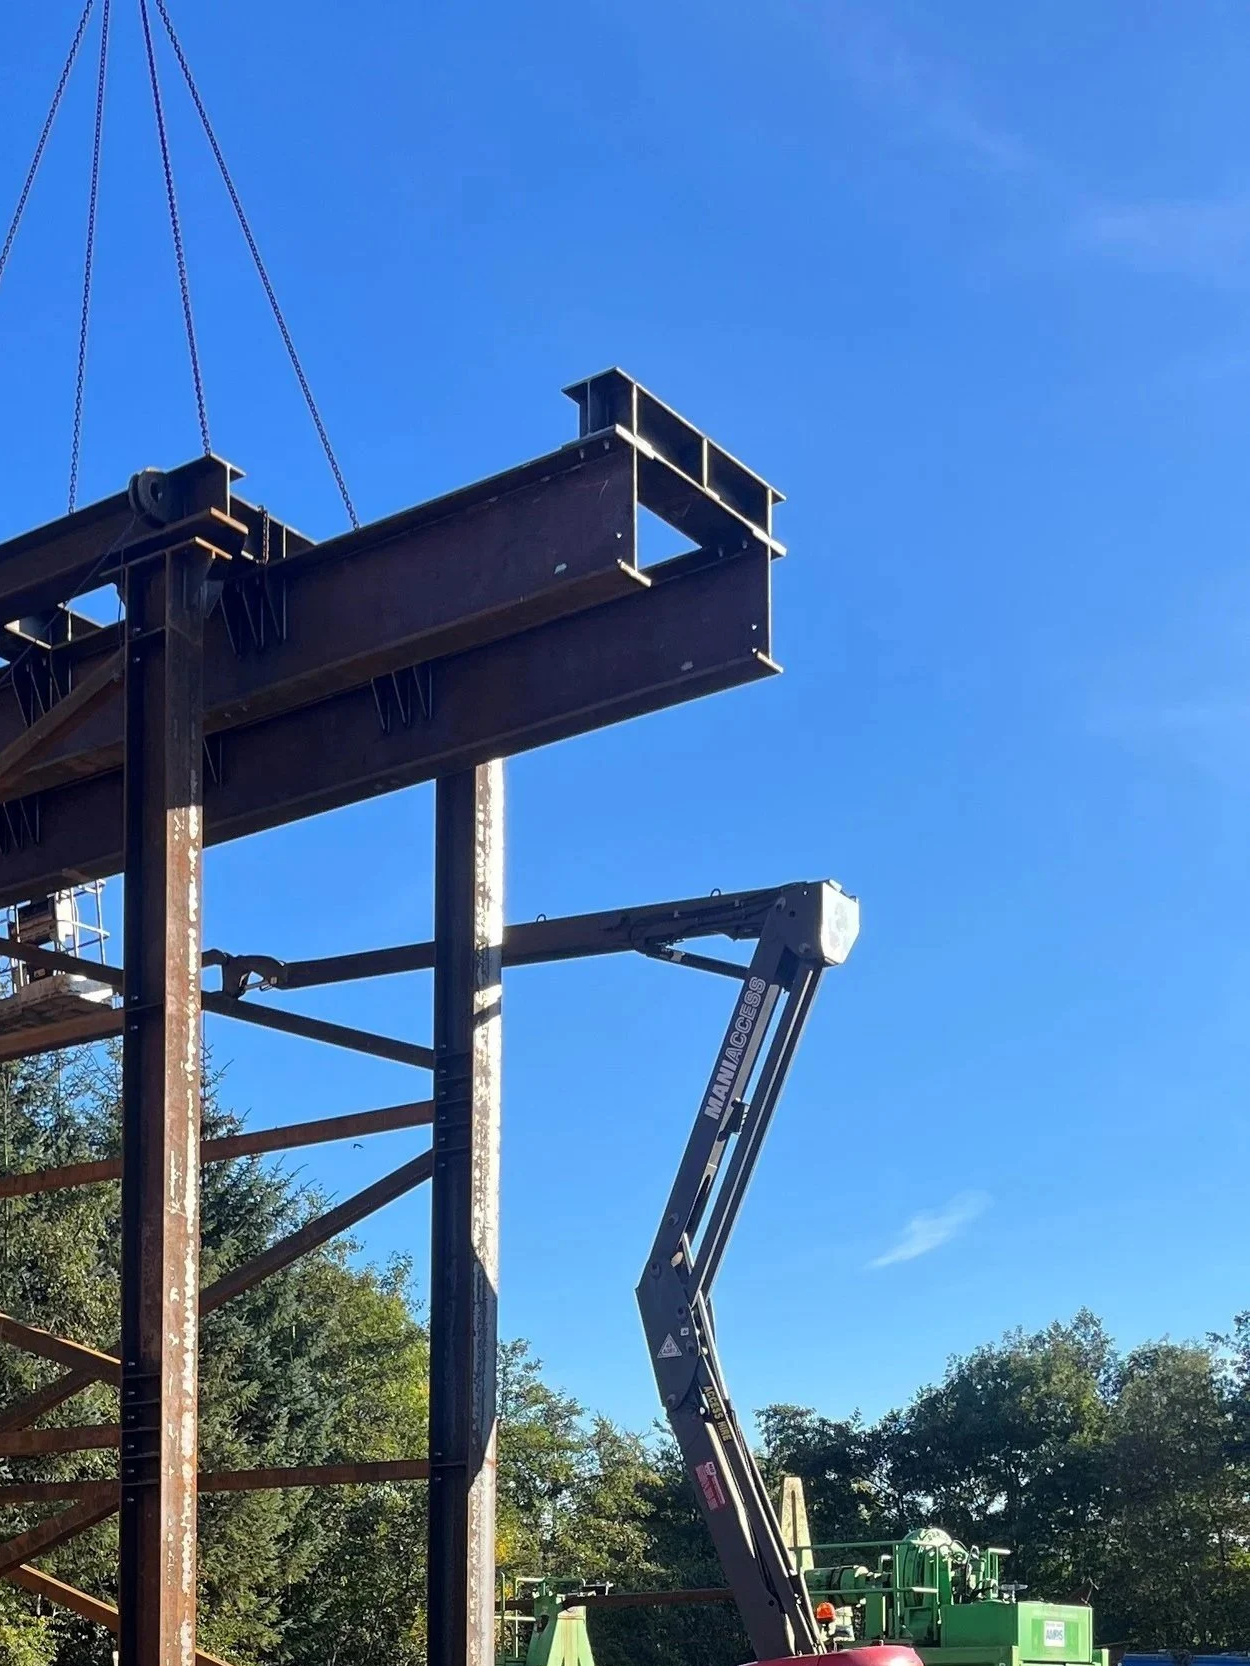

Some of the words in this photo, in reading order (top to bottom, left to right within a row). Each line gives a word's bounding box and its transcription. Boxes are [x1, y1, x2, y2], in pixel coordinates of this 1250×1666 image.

[704, 976, 766, 1120] MANIACCESS
[703, 1385, 724, 1420] ACCESS
[716, 1415, 733, 1442] HIRE
